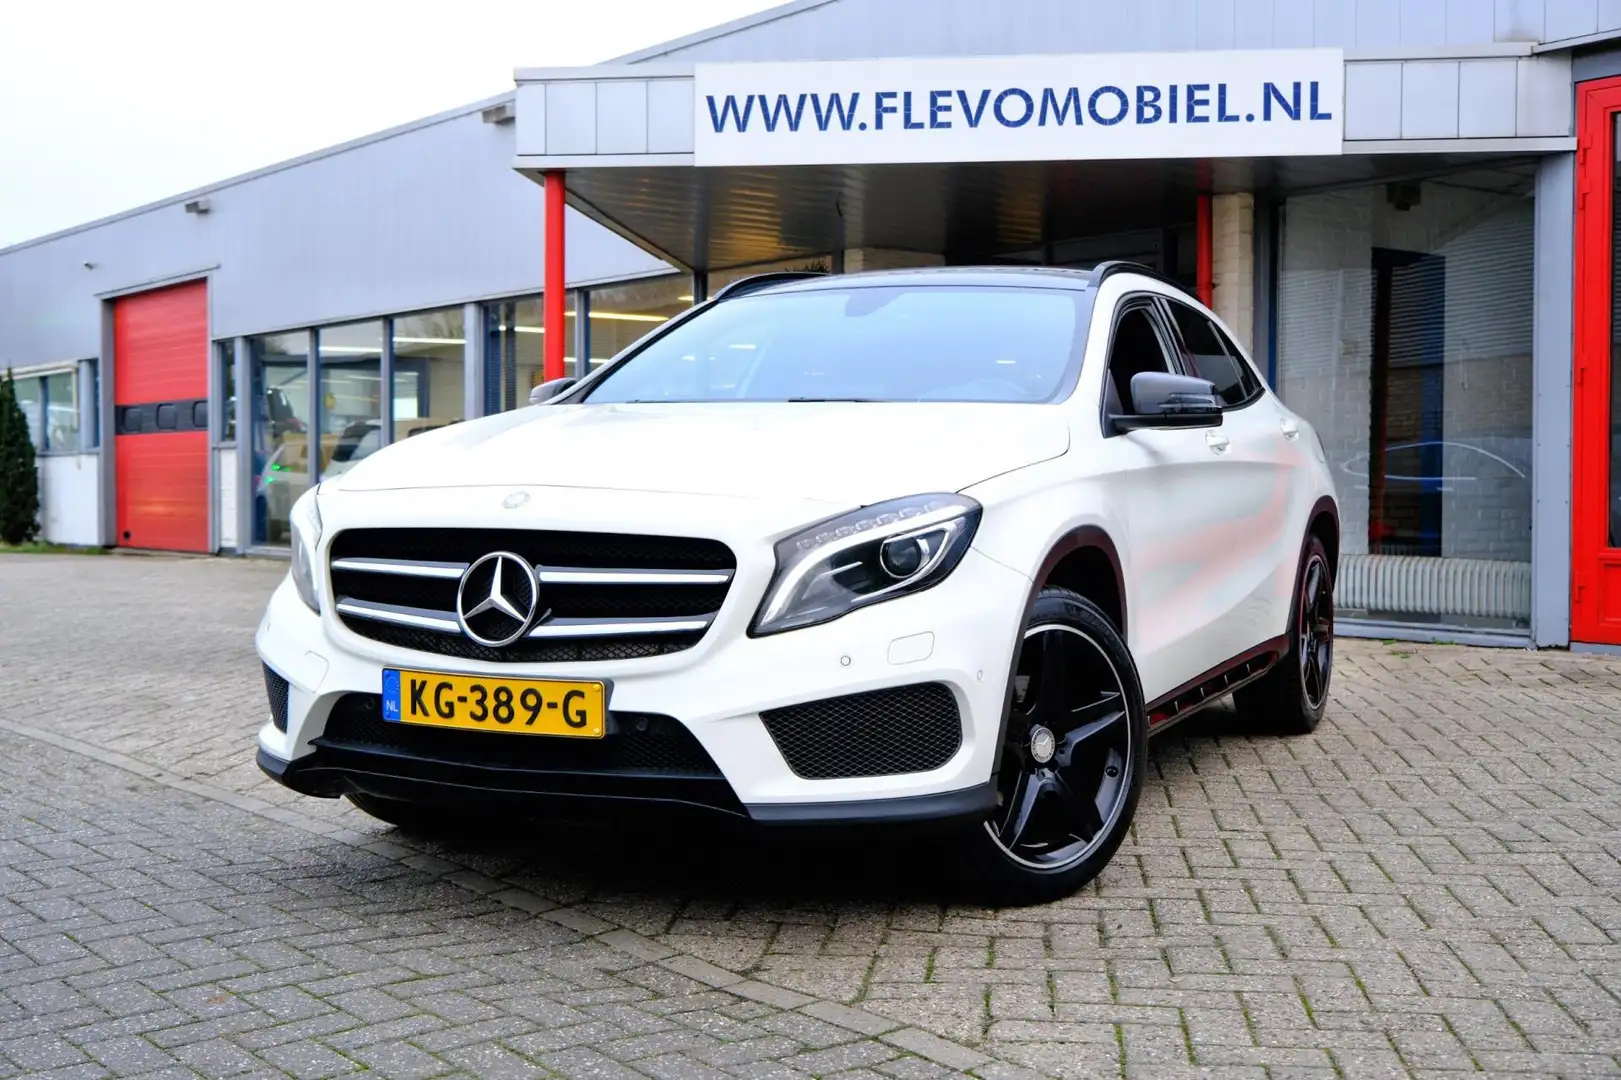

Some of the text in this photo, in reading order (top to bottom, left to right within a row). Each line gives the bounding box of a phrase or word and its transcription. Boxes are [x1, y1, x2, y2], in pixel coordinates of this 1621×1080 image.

[706, 81, 1333, 132] WWW.FLEVOMOBIEL.NL
[386, 699, 399, 712] NL
[410, 679, 587, 728] KG-389-G
